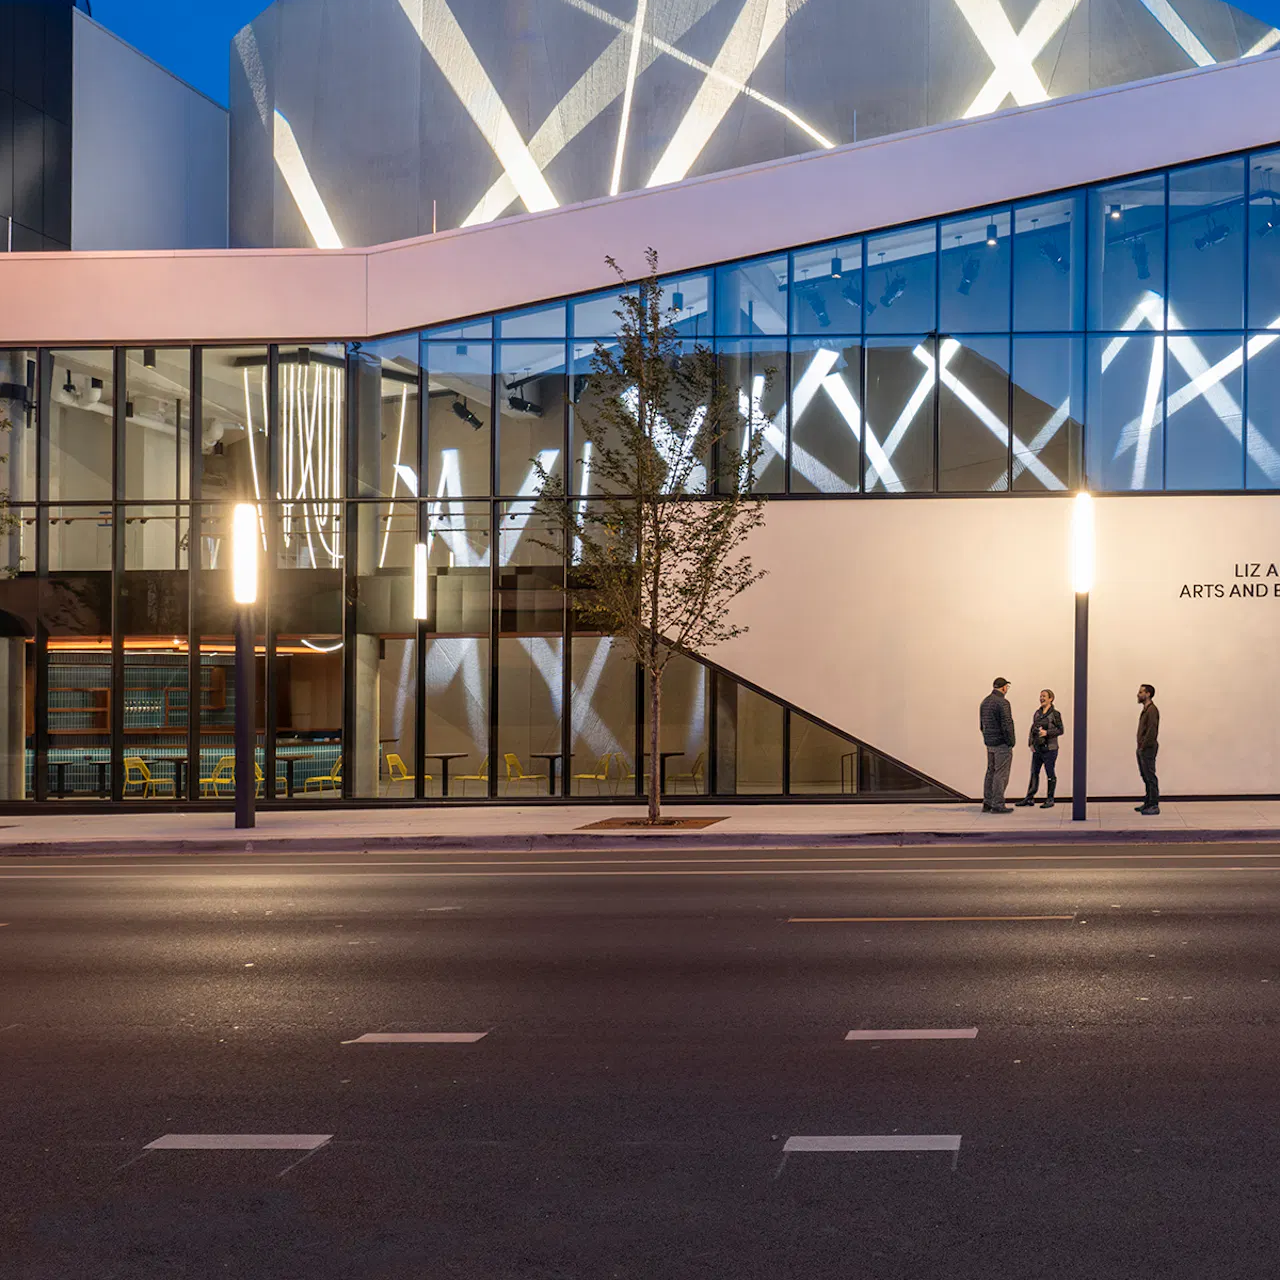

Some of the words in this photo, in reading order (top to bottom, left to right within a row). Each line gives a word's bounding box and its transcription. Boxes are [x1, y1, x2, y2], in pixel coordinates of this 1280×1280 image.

[1234, 563, 1261, 578] LIZ
[1179, 584, 1225, 599] ARTS
[1229, 583, 1269, 598] AND
